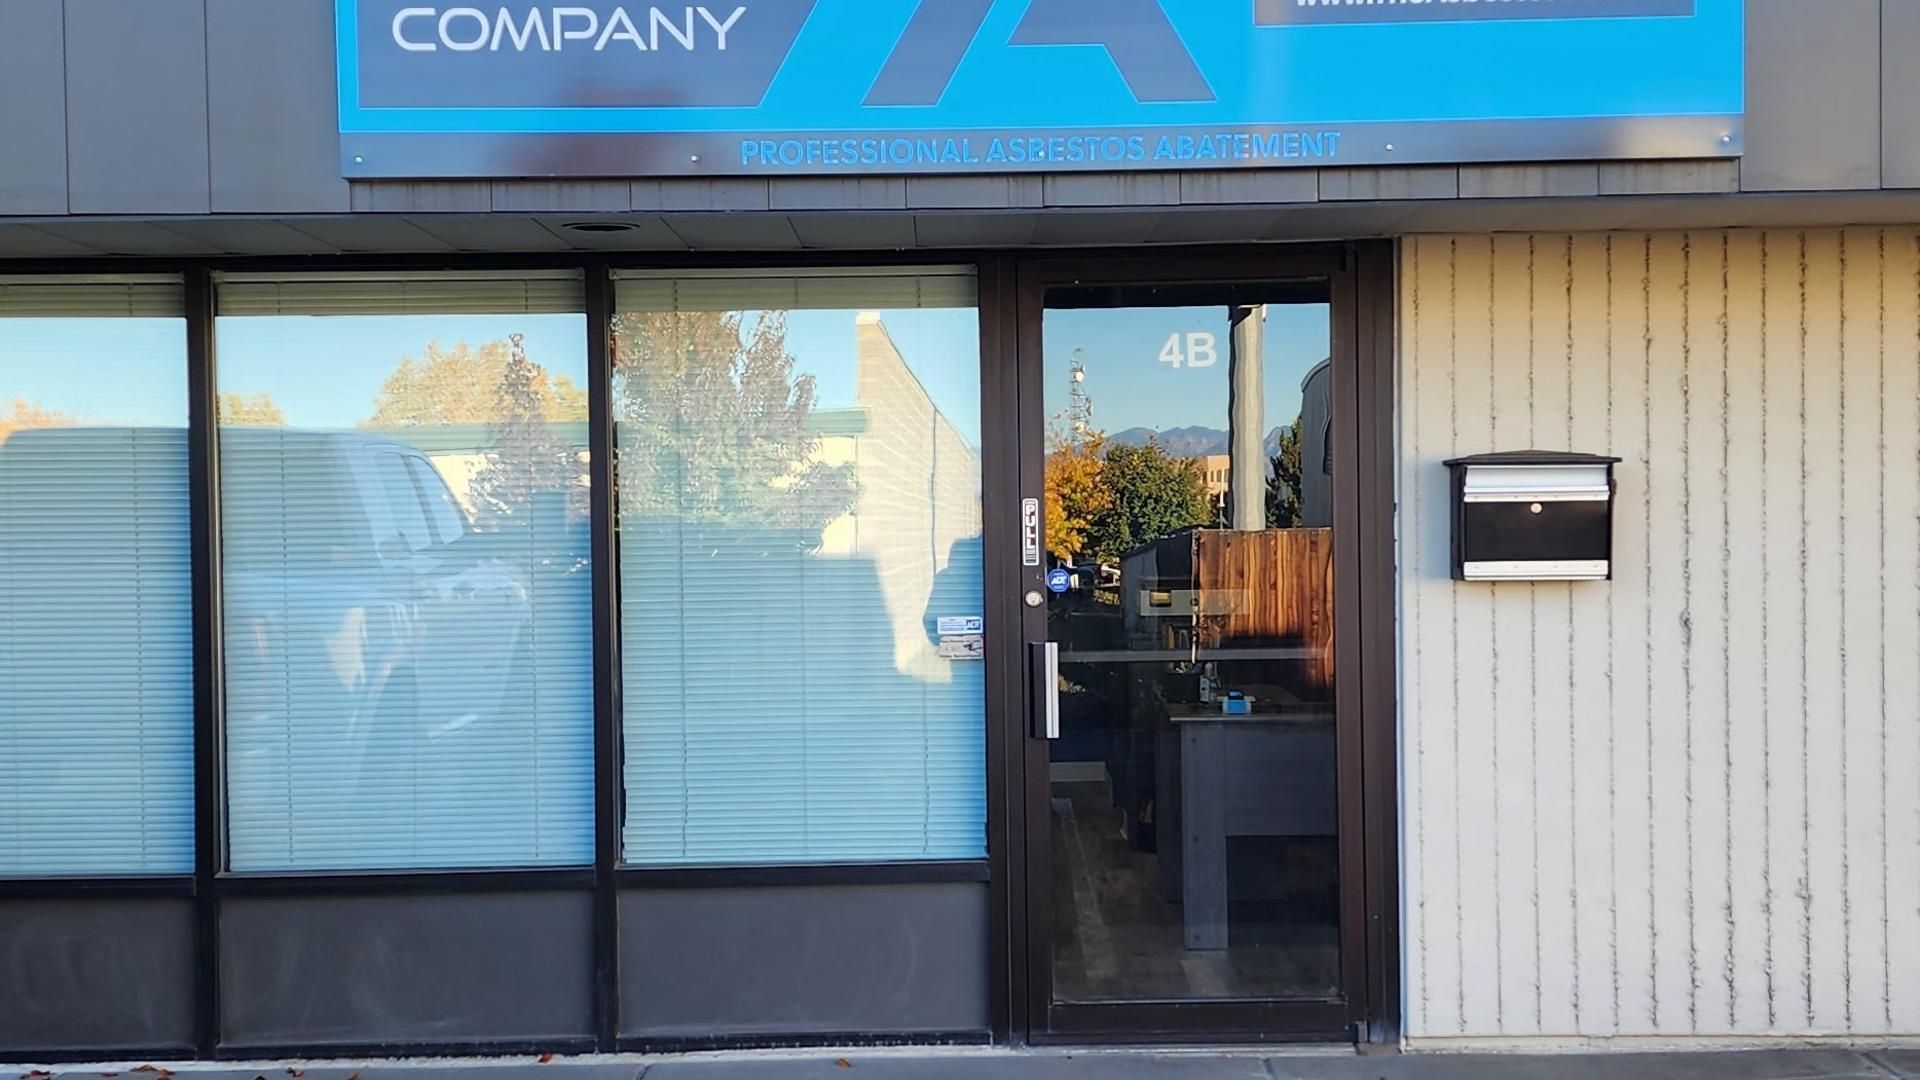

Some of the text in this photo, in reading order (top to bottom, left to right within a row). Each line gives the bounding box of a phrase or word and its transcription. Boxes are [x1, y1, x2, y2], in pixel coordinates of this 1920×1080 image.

[392, 6, 747, 51] COMPANY
[741, 131, 1341, 166] PROFESSIONAL ASBESTOS ABATEMENT
[1158, 332, 1217, 368] 4B
[1025, 504, 1036, 549] PULL
